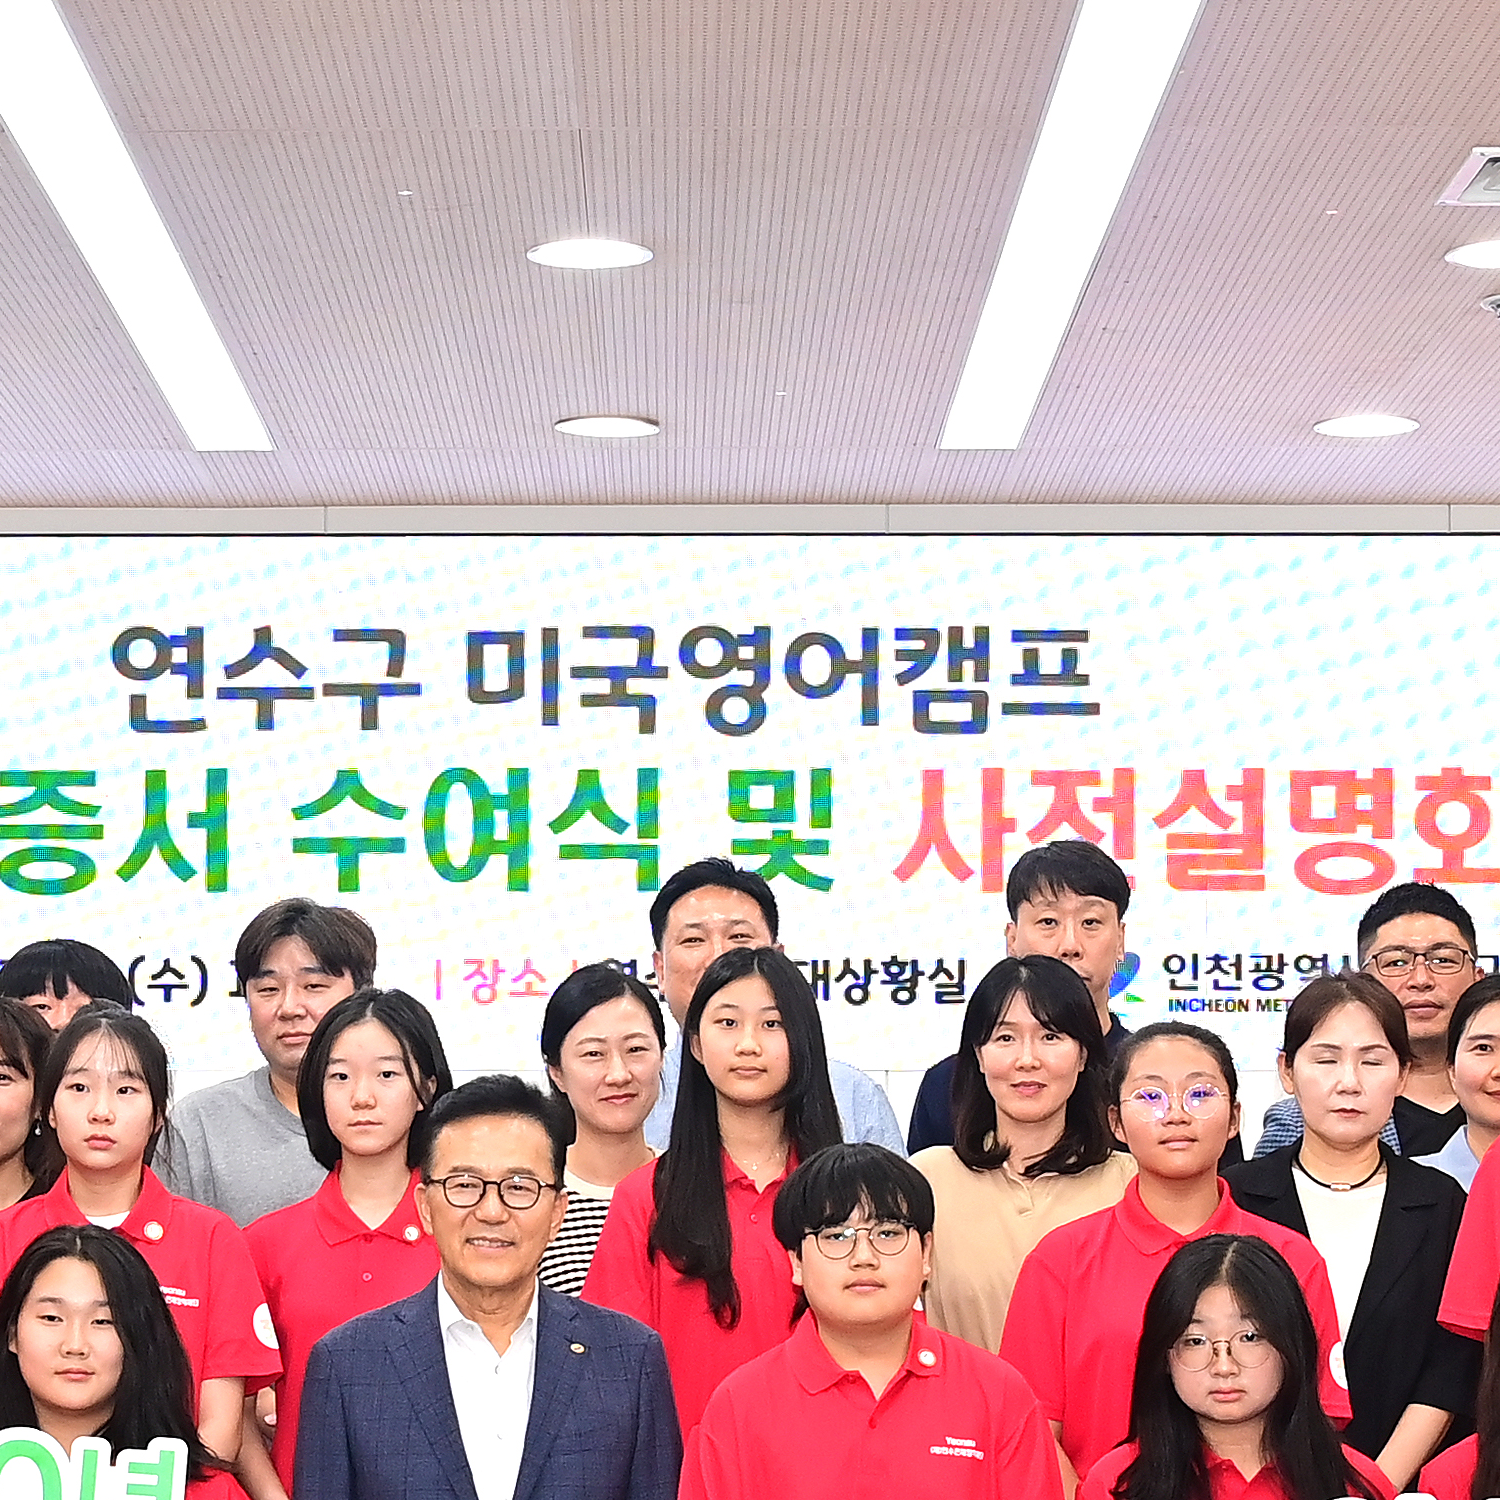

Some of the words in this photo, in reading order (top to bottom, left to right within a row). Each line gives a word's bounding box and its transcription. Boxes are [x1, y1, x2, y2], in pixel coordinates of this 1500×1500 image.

[112, 626, 422, 734] 연수구
[466, 625, 1102, 736] 미국영어캠프
[289, 766, 660, 896] 수여식
[726, 766, 835, 896] 및
[463, 958, 550, 1004] 장소
[1168, 998, 1250, 1013] INCHEON
